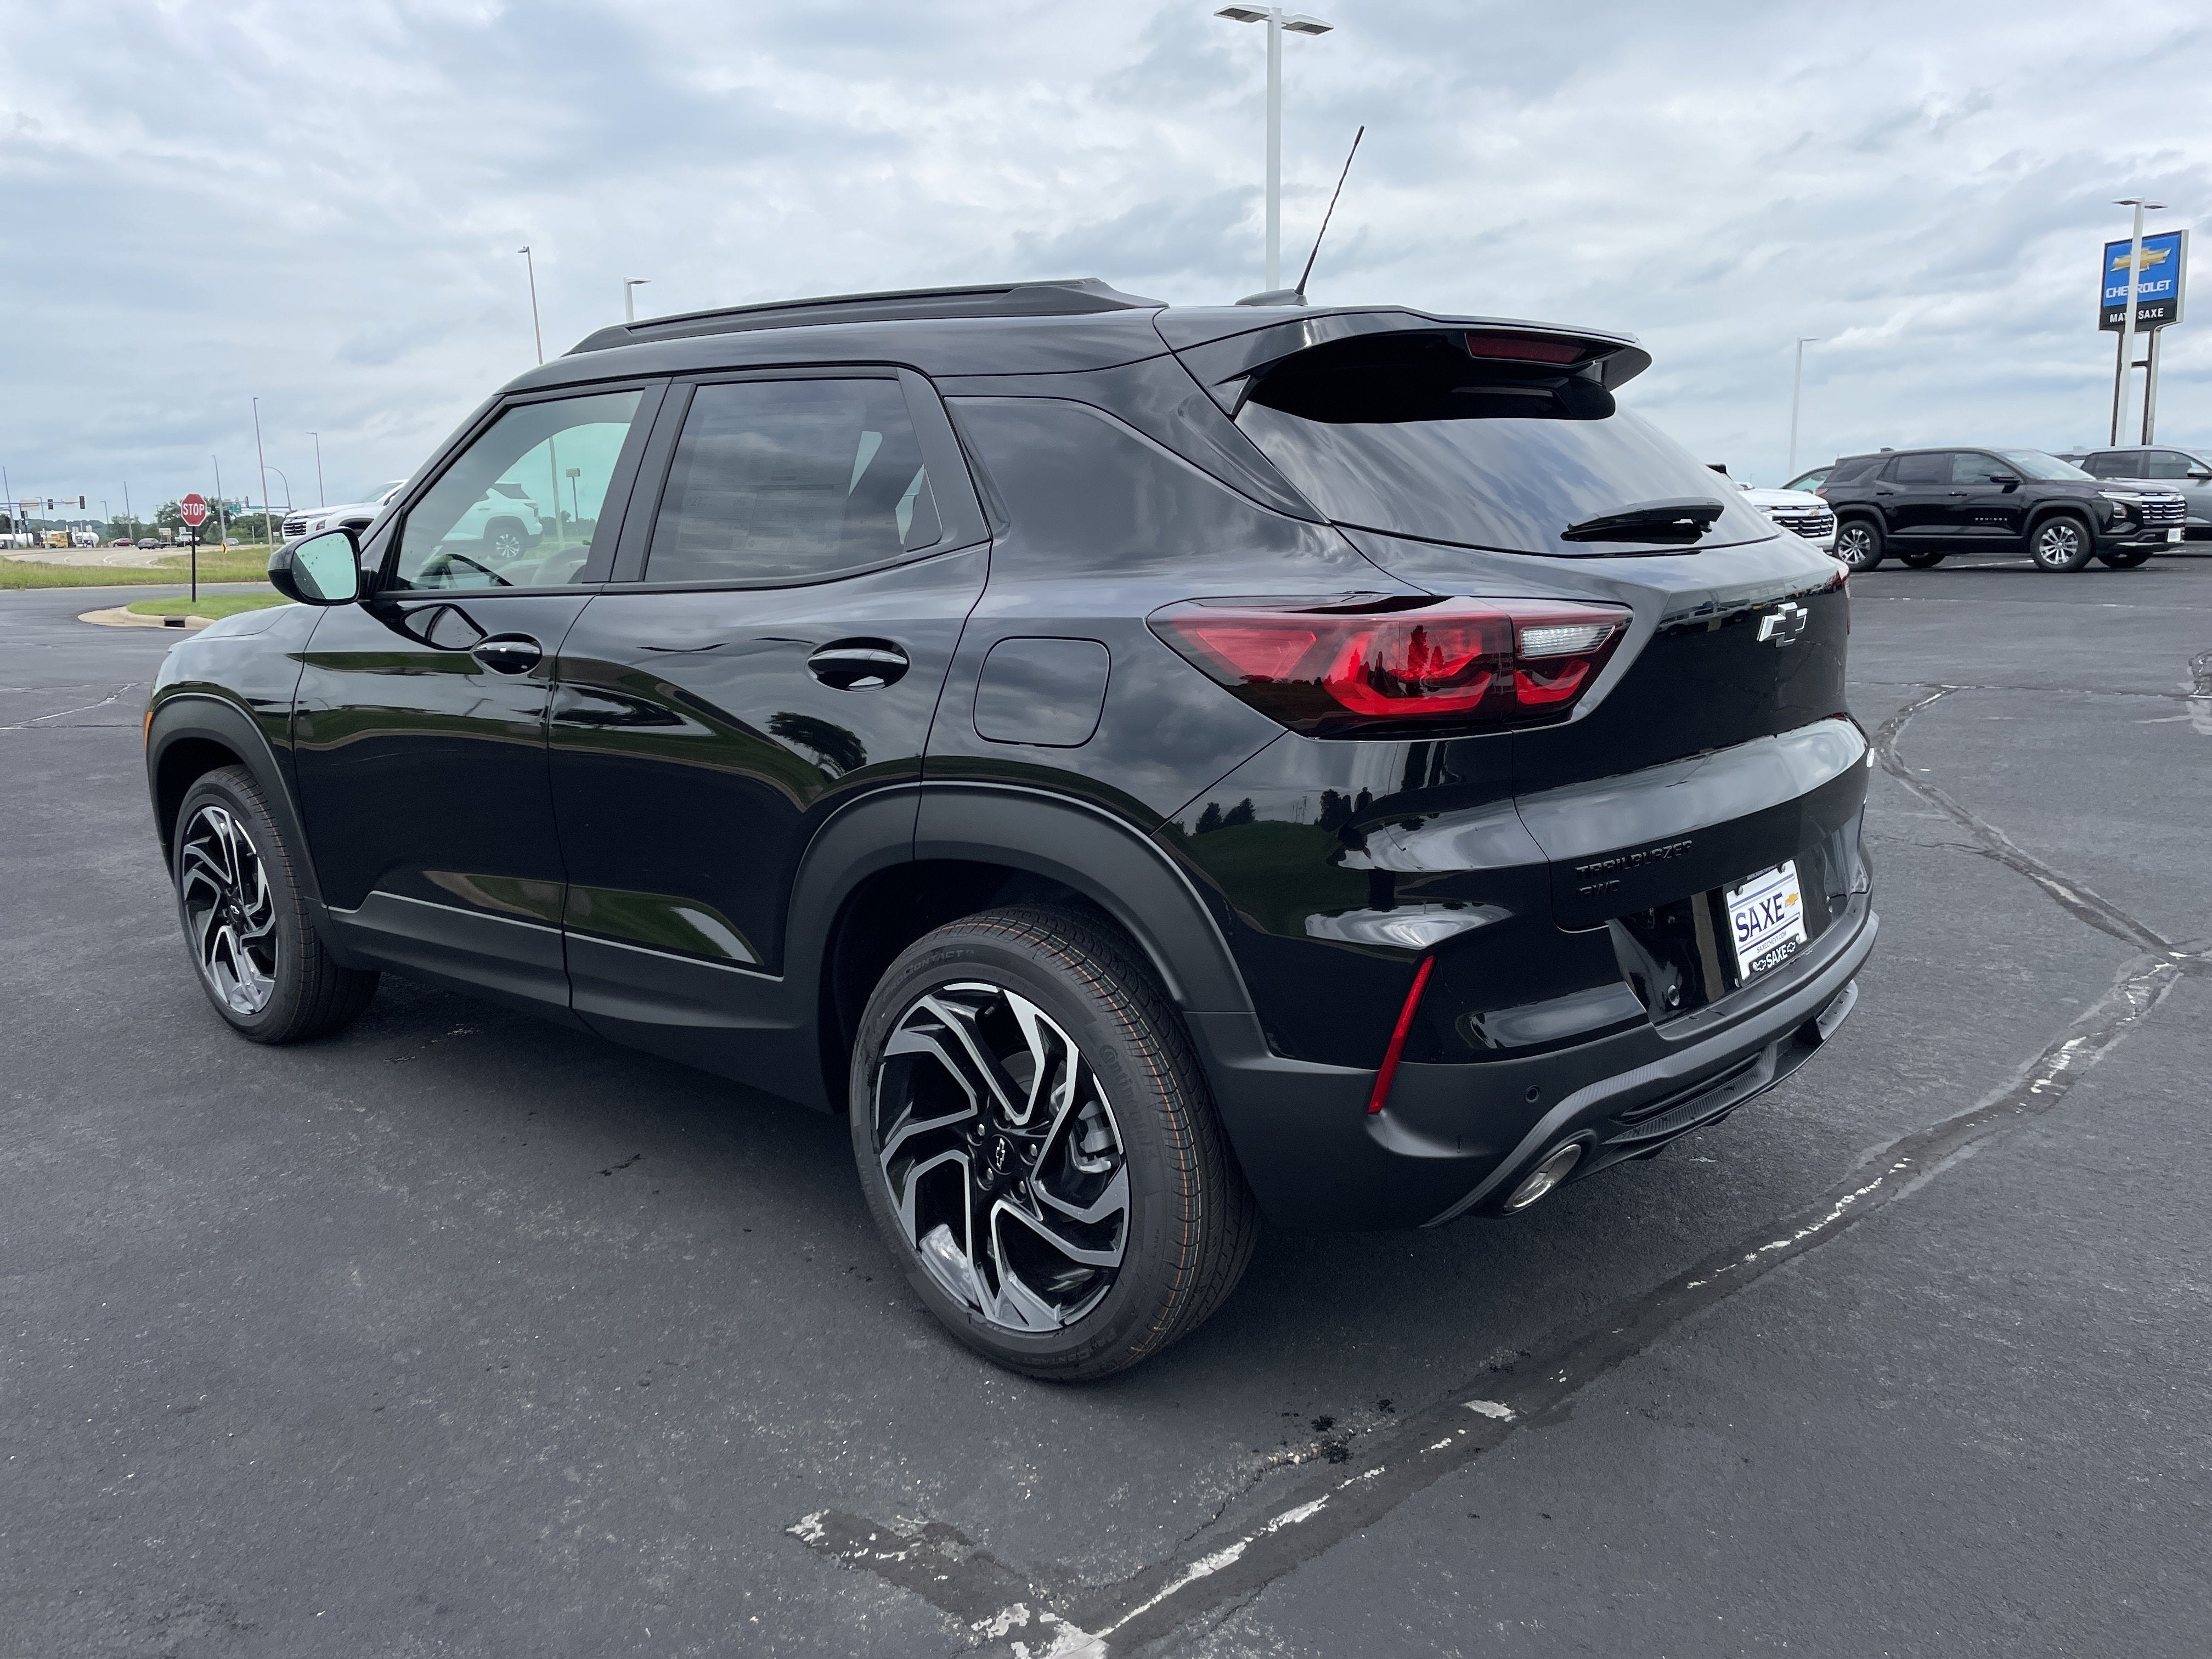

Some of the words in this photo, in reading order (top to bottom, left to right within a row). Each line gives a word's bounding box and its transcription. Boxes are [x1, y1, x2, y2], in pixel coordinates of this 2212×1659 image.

[2106, 280, 2171, 298] CHEROLET
[2138, 308, 2164, 319] SAXE
[183, 503, 205, 516] STOP
[1575, 840, 1692, 879] TRAILBLAZER
[1735, 891, 1785, 942] SAXE
[1757, 931, 1787, 953] SAXECHEVY.COM
[1765, 944, 1788, 968] SAXE
